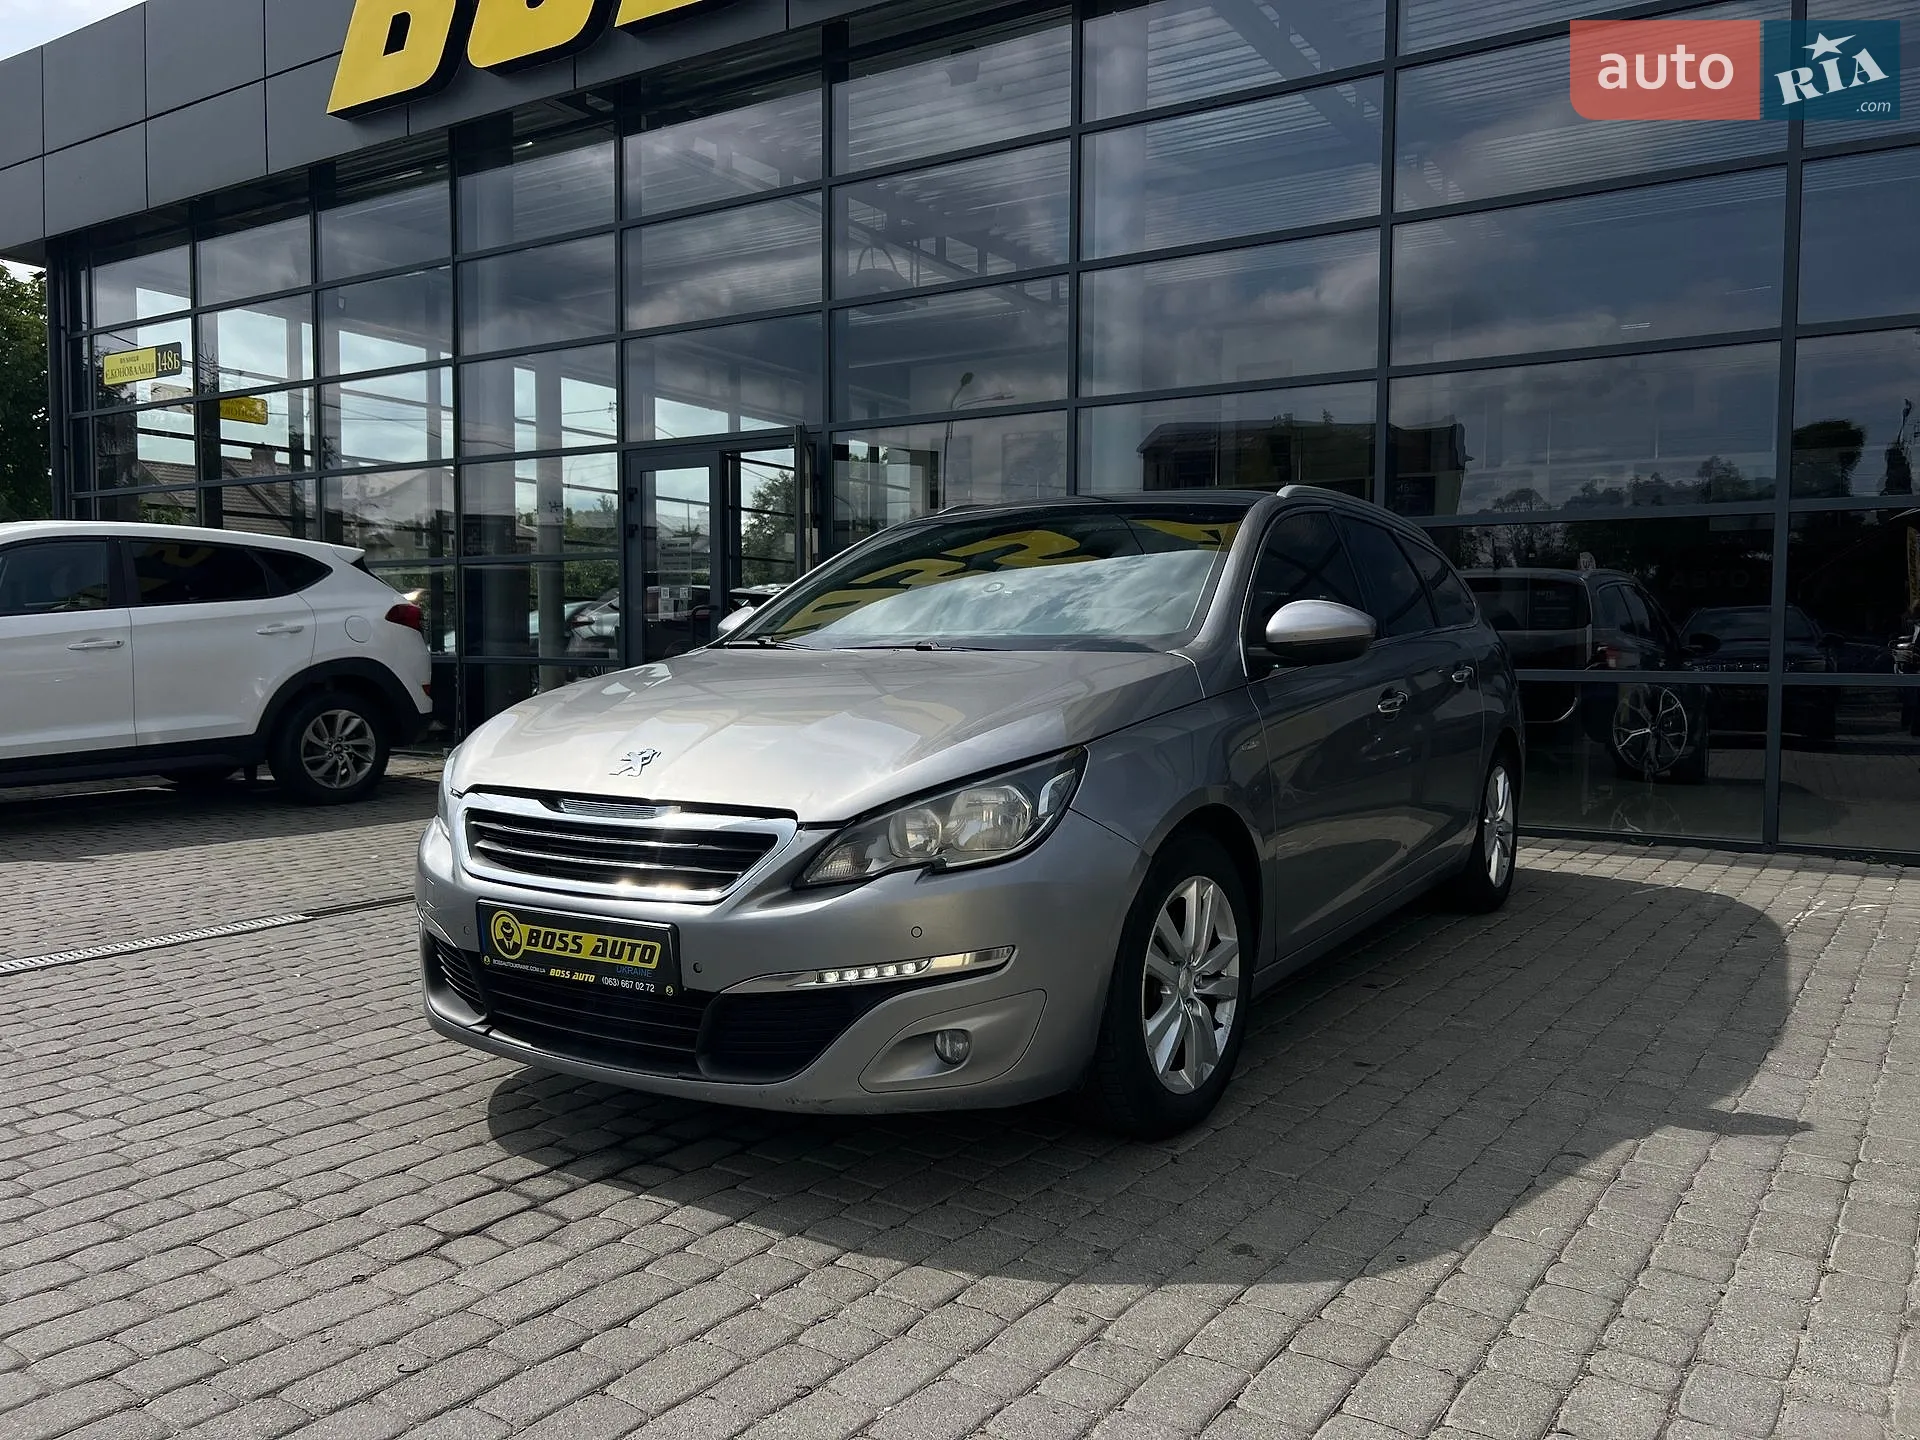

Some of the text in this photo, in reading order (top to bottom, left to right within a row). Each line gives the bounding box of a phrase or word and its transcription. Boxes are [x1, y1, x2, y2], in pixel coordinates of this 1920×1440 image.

[157, 350, 180, 372] 148Б
[526, 928, 657, 965] BOSS AUTO
[549, 968, 571, 980] BOSS
[572, 972, 596, 983] AUTO
[601, 976, 620, 988] (063)
[620, 979, 634, 990] 667
[635, 981, 645, 991] 02
[645, 983, 655, 993] 72
[616, 965, 653, 978] UKRAINE
